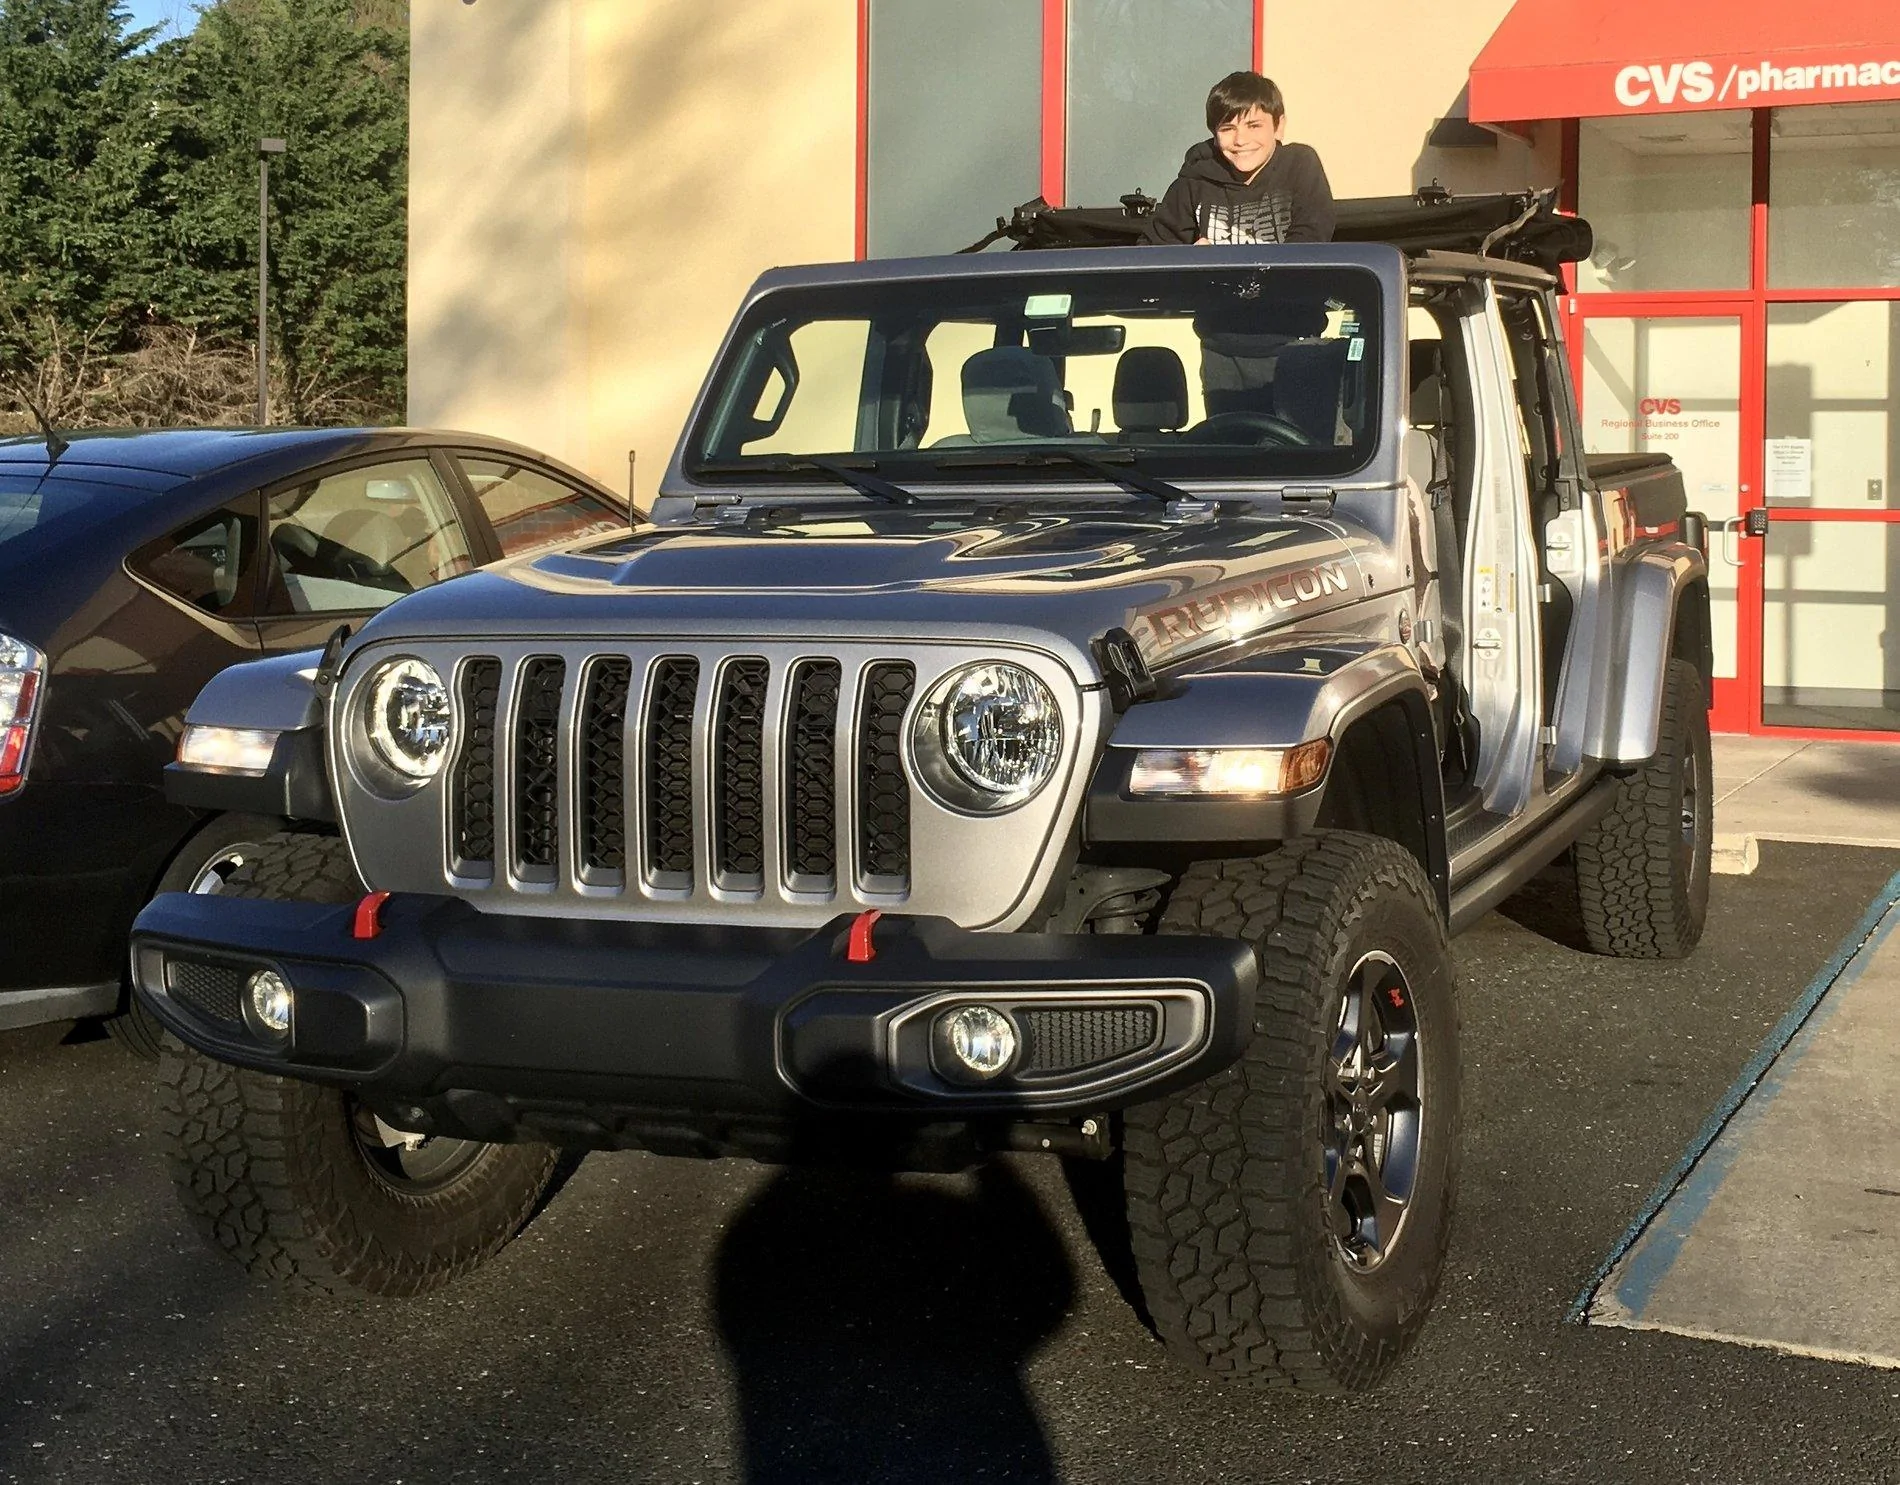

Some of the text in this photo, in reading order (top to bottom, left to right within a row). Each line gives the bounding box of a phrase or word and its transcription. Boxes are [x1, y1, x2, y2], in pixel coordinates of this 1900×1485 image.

[1640, 398, 1682, 415] CVS
[1600, 419, 1720, 430] Regional Business Office
[1641, 432, 1680, 441] Suite 200
[1147, 562, 1349, 647] RUBICON
